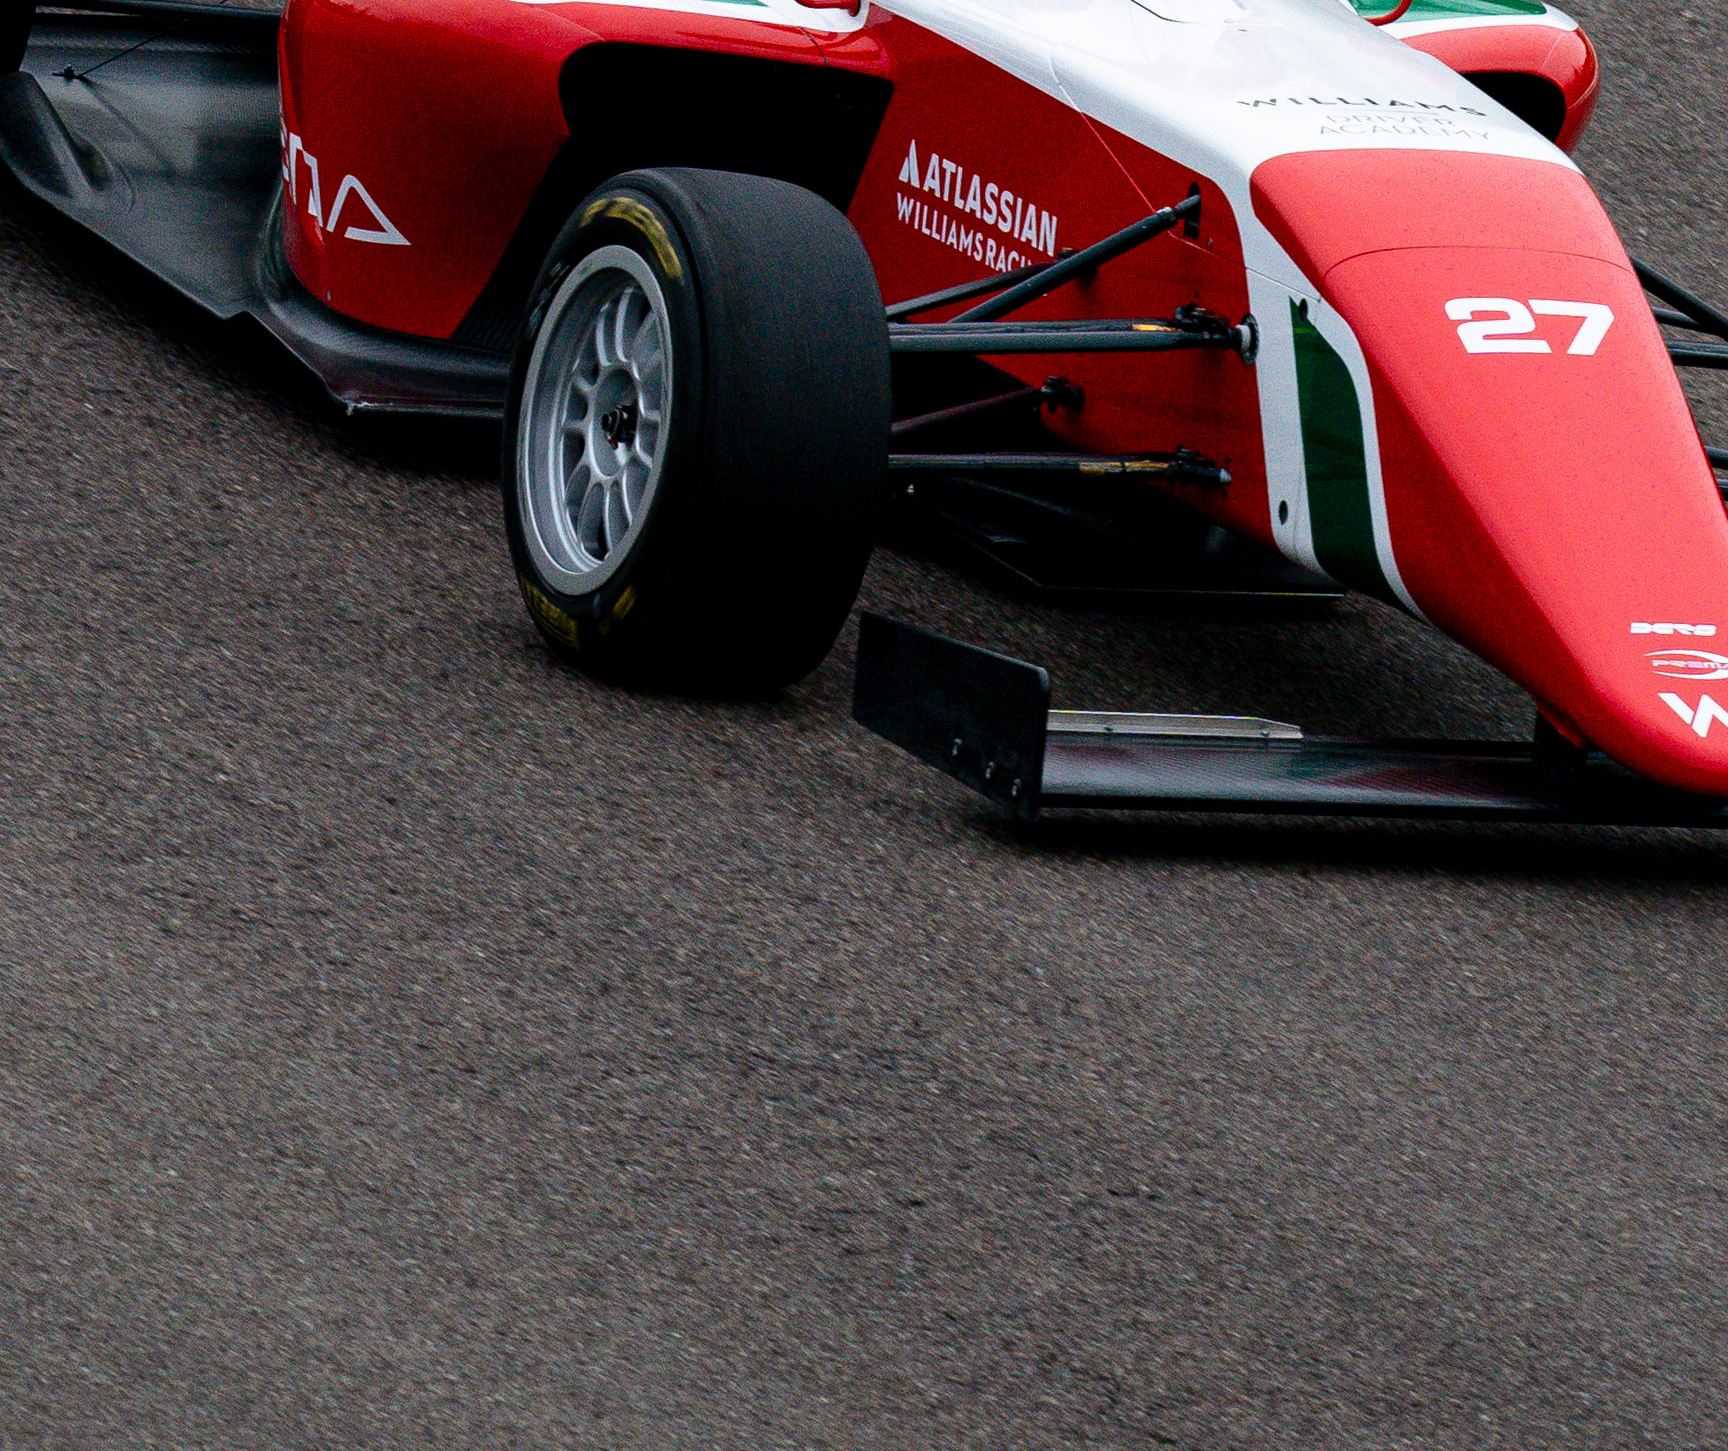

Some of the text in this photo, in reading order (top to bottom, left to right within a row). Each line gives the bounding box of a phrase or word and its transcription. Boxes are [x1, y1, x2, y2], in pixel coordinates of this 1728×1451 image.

[1236, 96, 1487, 117] WILLIAMS
[1320, 124, 1489, 140] ACADEMY
[923, 152, 1058, 257] ATLASSIAN
[1444, 297, 1615, 356] 27
